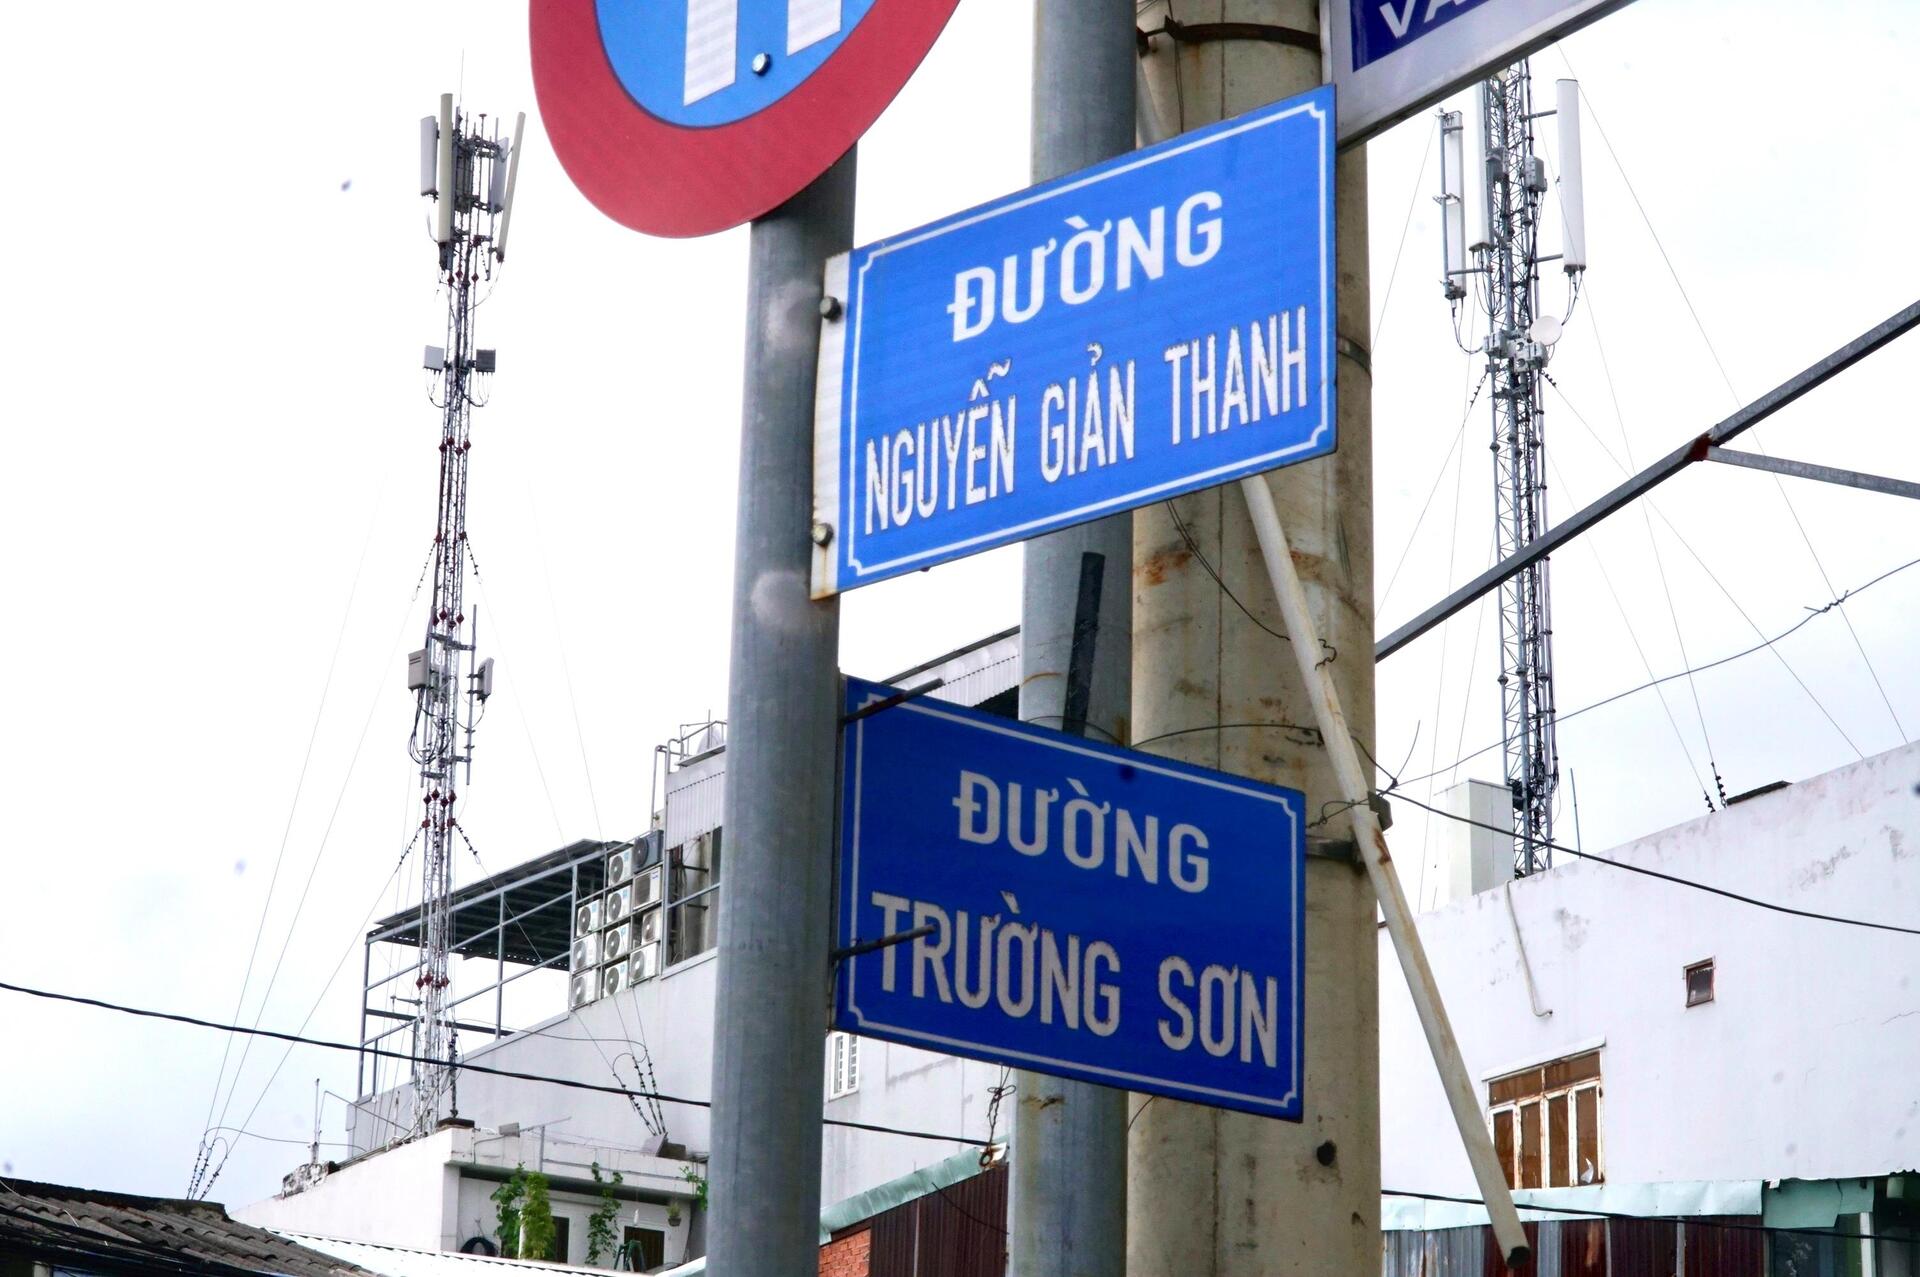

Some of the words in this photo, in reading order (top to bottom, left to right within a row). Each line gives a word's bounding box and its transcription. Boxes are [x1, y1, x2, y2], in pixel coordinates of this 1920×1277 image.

[946, 190, 1223, 343] ĐƯỜNG
[864, 358, 1016, 535] NGUYỄN
[1040, 342, 1136, 484] GIẢN
[1164, 305, 1307, 446] THANH
[952, 770, 1209, 893] ĐƯỜNG
[872, 890, 1121, 1038] TRƯỜNG
[1158, 956, 1278, 1068] SƠN
